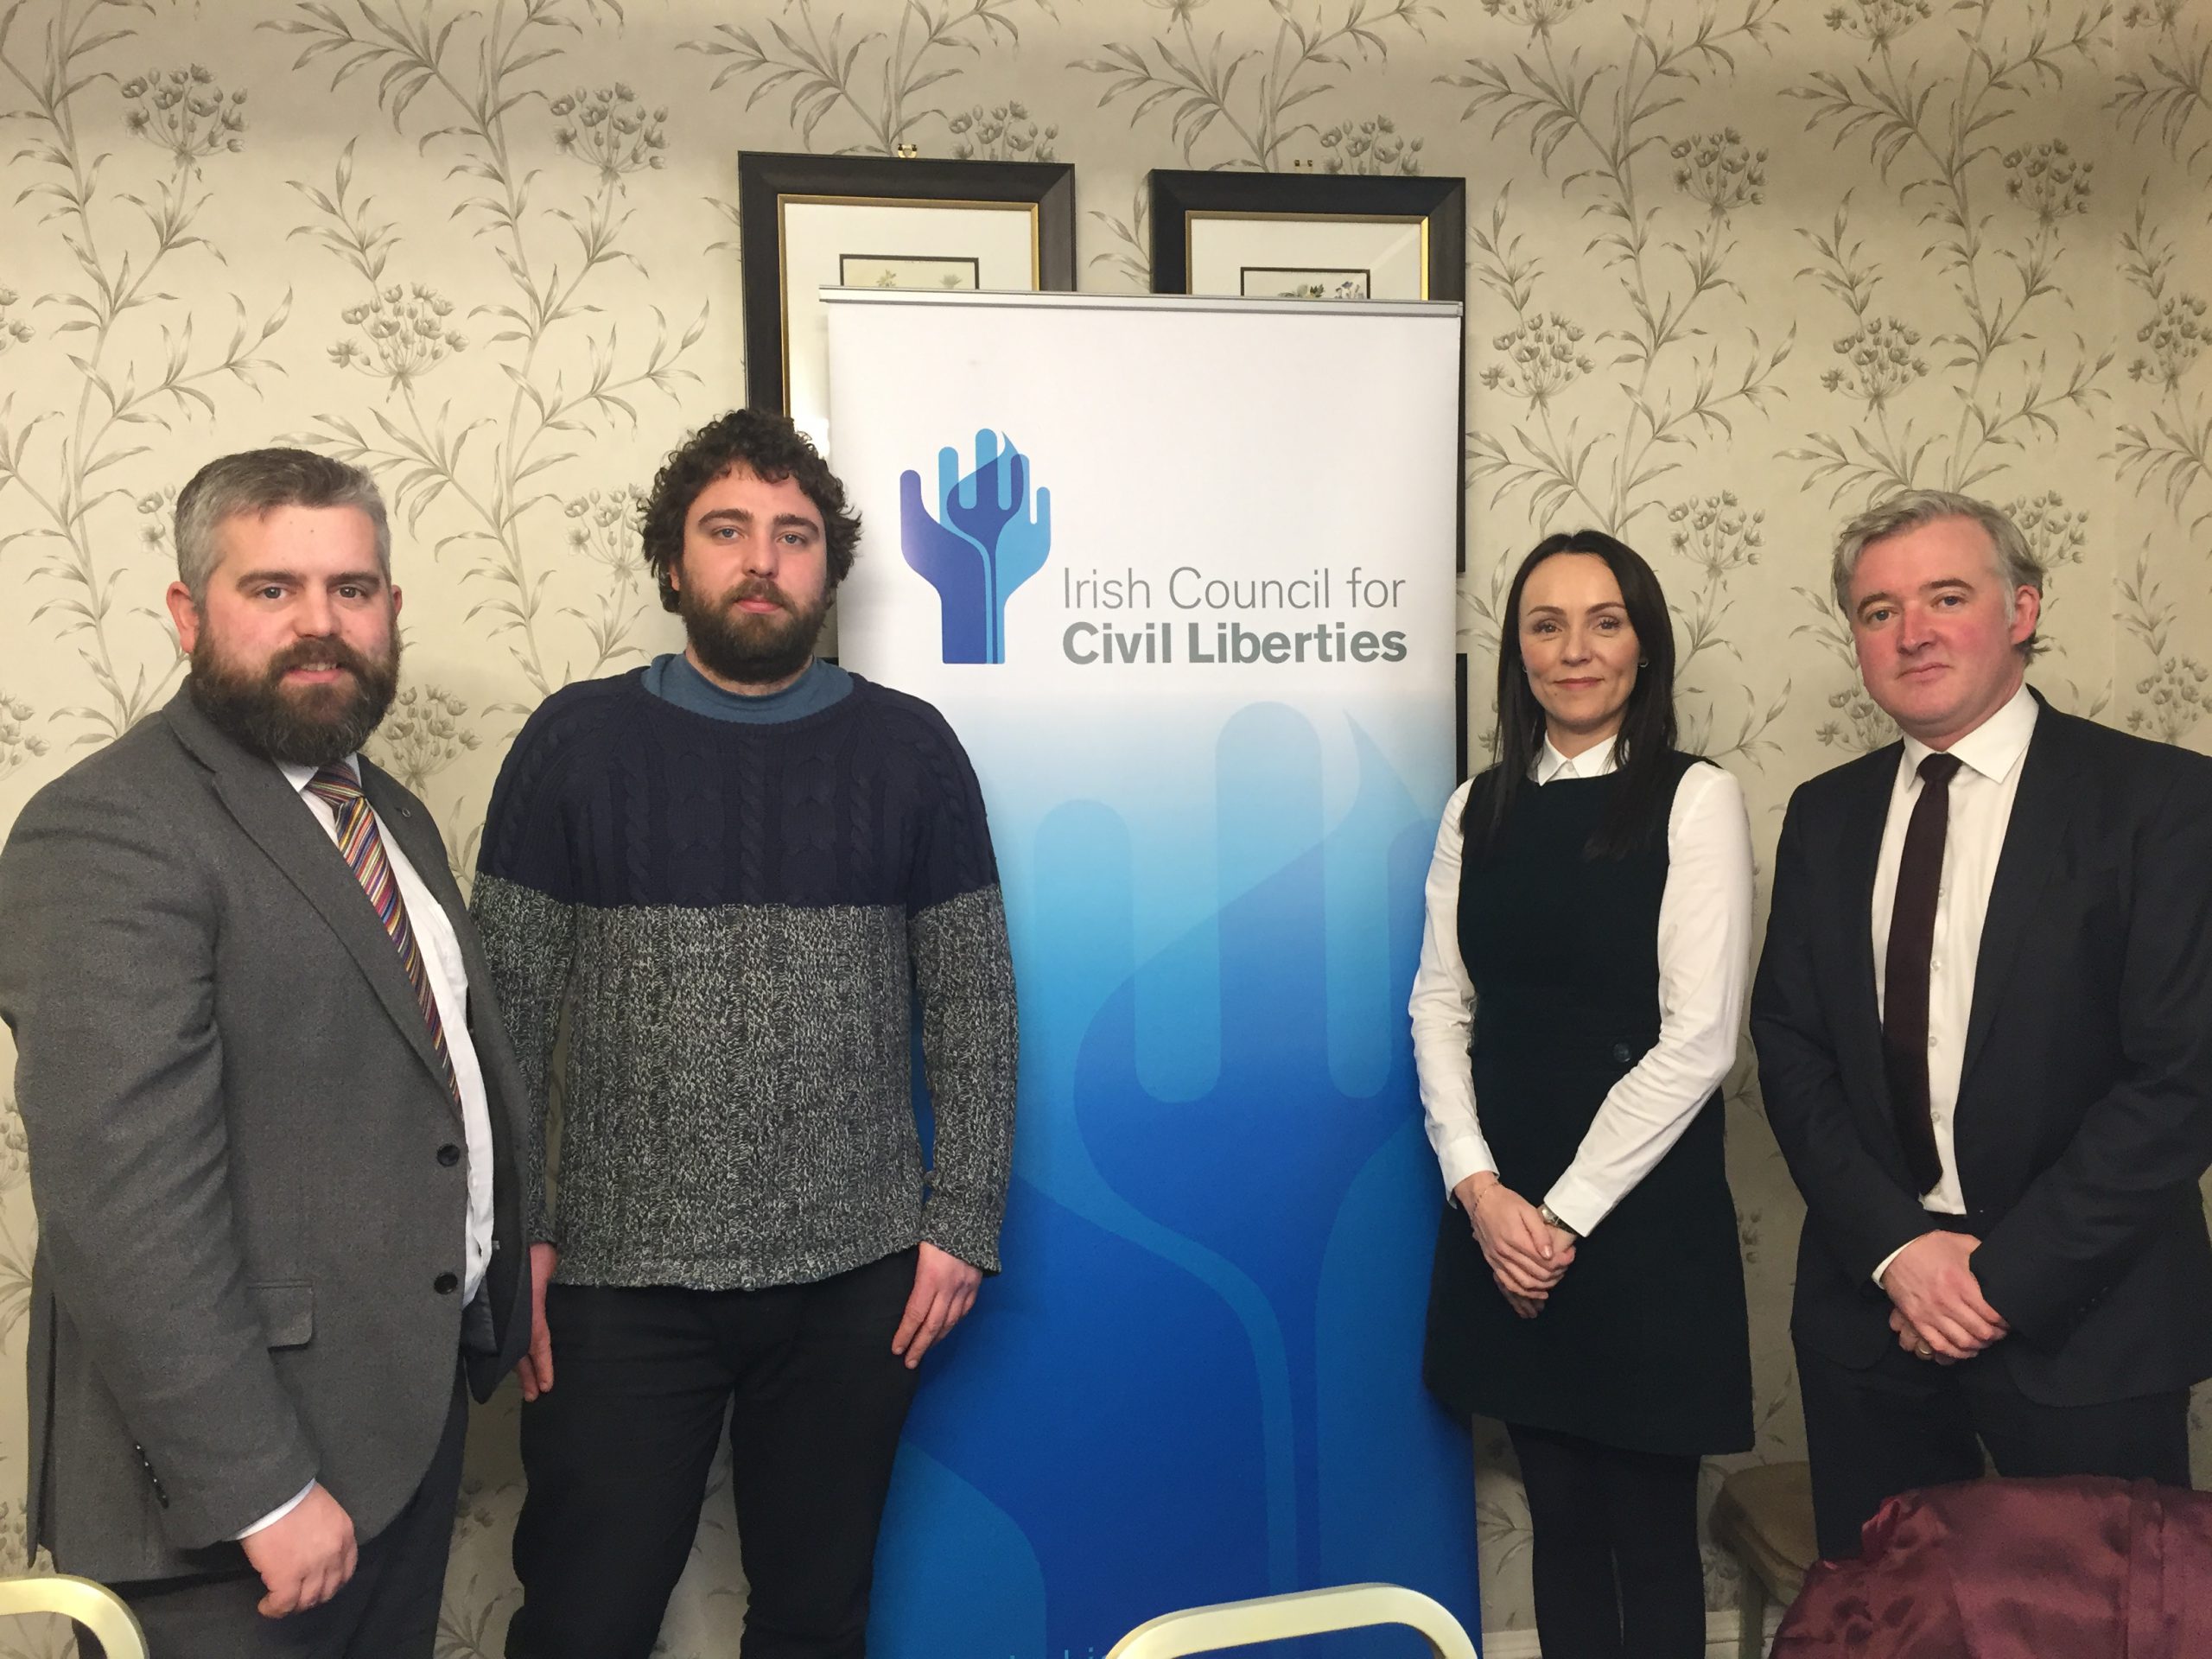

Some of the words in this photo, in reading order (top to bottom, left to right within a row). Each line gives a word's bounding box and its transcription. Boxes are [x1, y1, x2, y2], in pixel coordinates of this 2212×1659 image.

[1064, 567, 1151, 609] Irish
[1168, 566, 1330, 610] Council
[1345, 566, 1407, 609] for
[1062, 621, 1173, 665] Civil
[1187, 621, 1408, 664] Liberties
